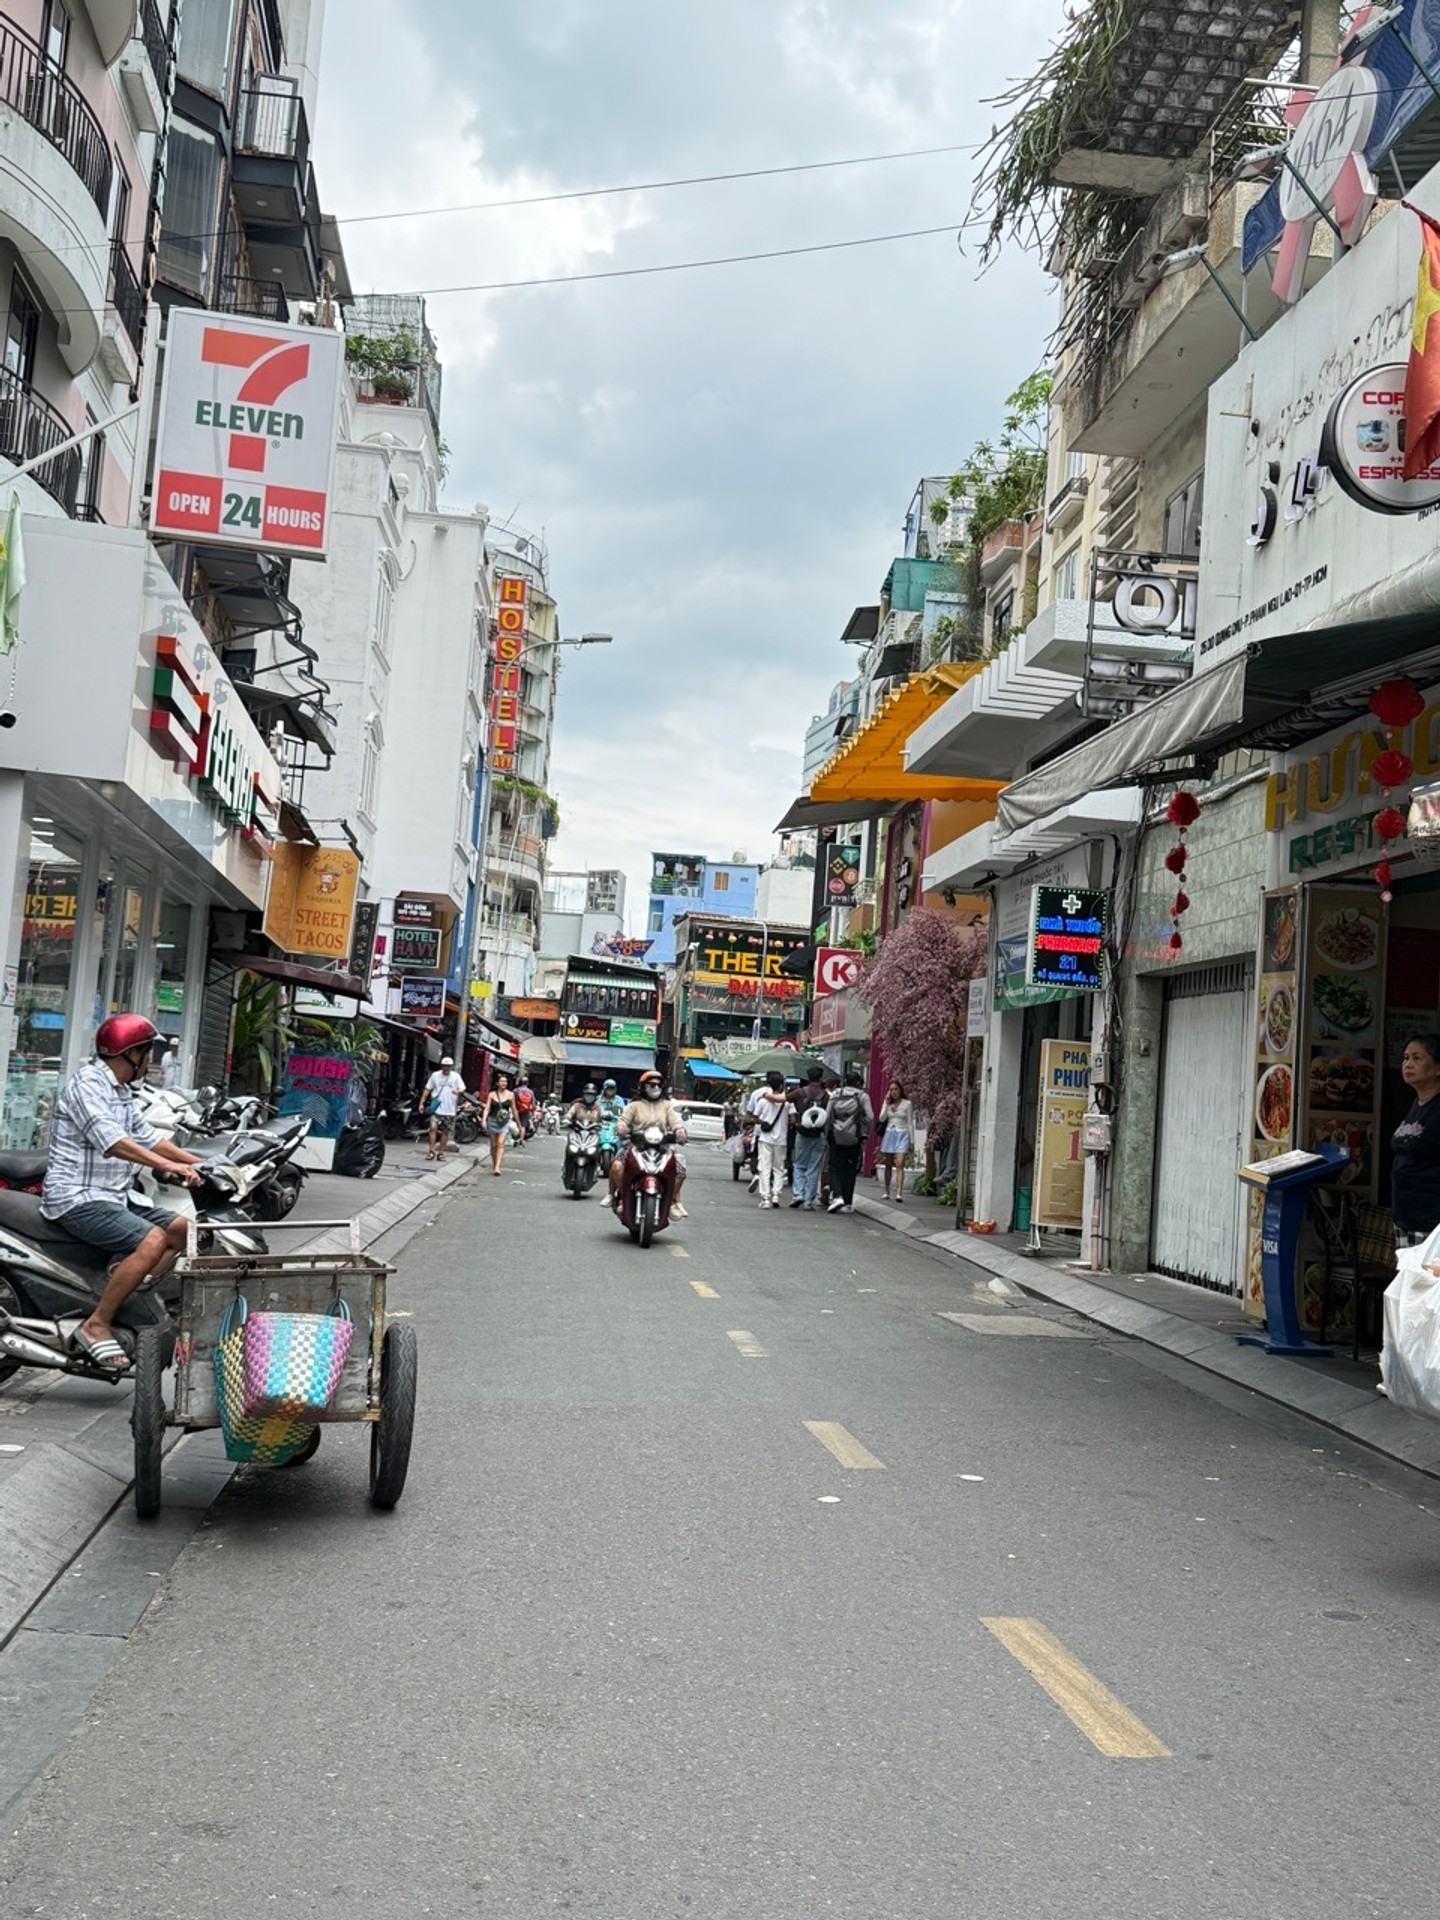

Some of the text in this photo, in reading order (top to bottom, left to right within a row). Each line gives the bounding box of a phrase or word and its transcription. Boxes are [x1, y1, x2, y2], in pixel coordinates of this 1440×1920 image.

[201, 327, 310, 406] 7
[1363, 391, 1406, 405] COF
[168, 491, 322, 530] OPEN 24 HOURS
[494, 580, 522, 749] HOSTEL
[295, 909, 349, 929] STREET
[295, 929, 344, 950] TACOS
[396, 930, 436, 943] HOTEL
[1036, 934, 1102, 954] PHARMACY
[416, 943, 436, 957] VY
[705, 949, 784, 976] THE R
[1059, 954, 1077, 970] 21
[1062, 1050, 1088, 1065] PHA
[1262, 1240, 1280, 1256] VISA
